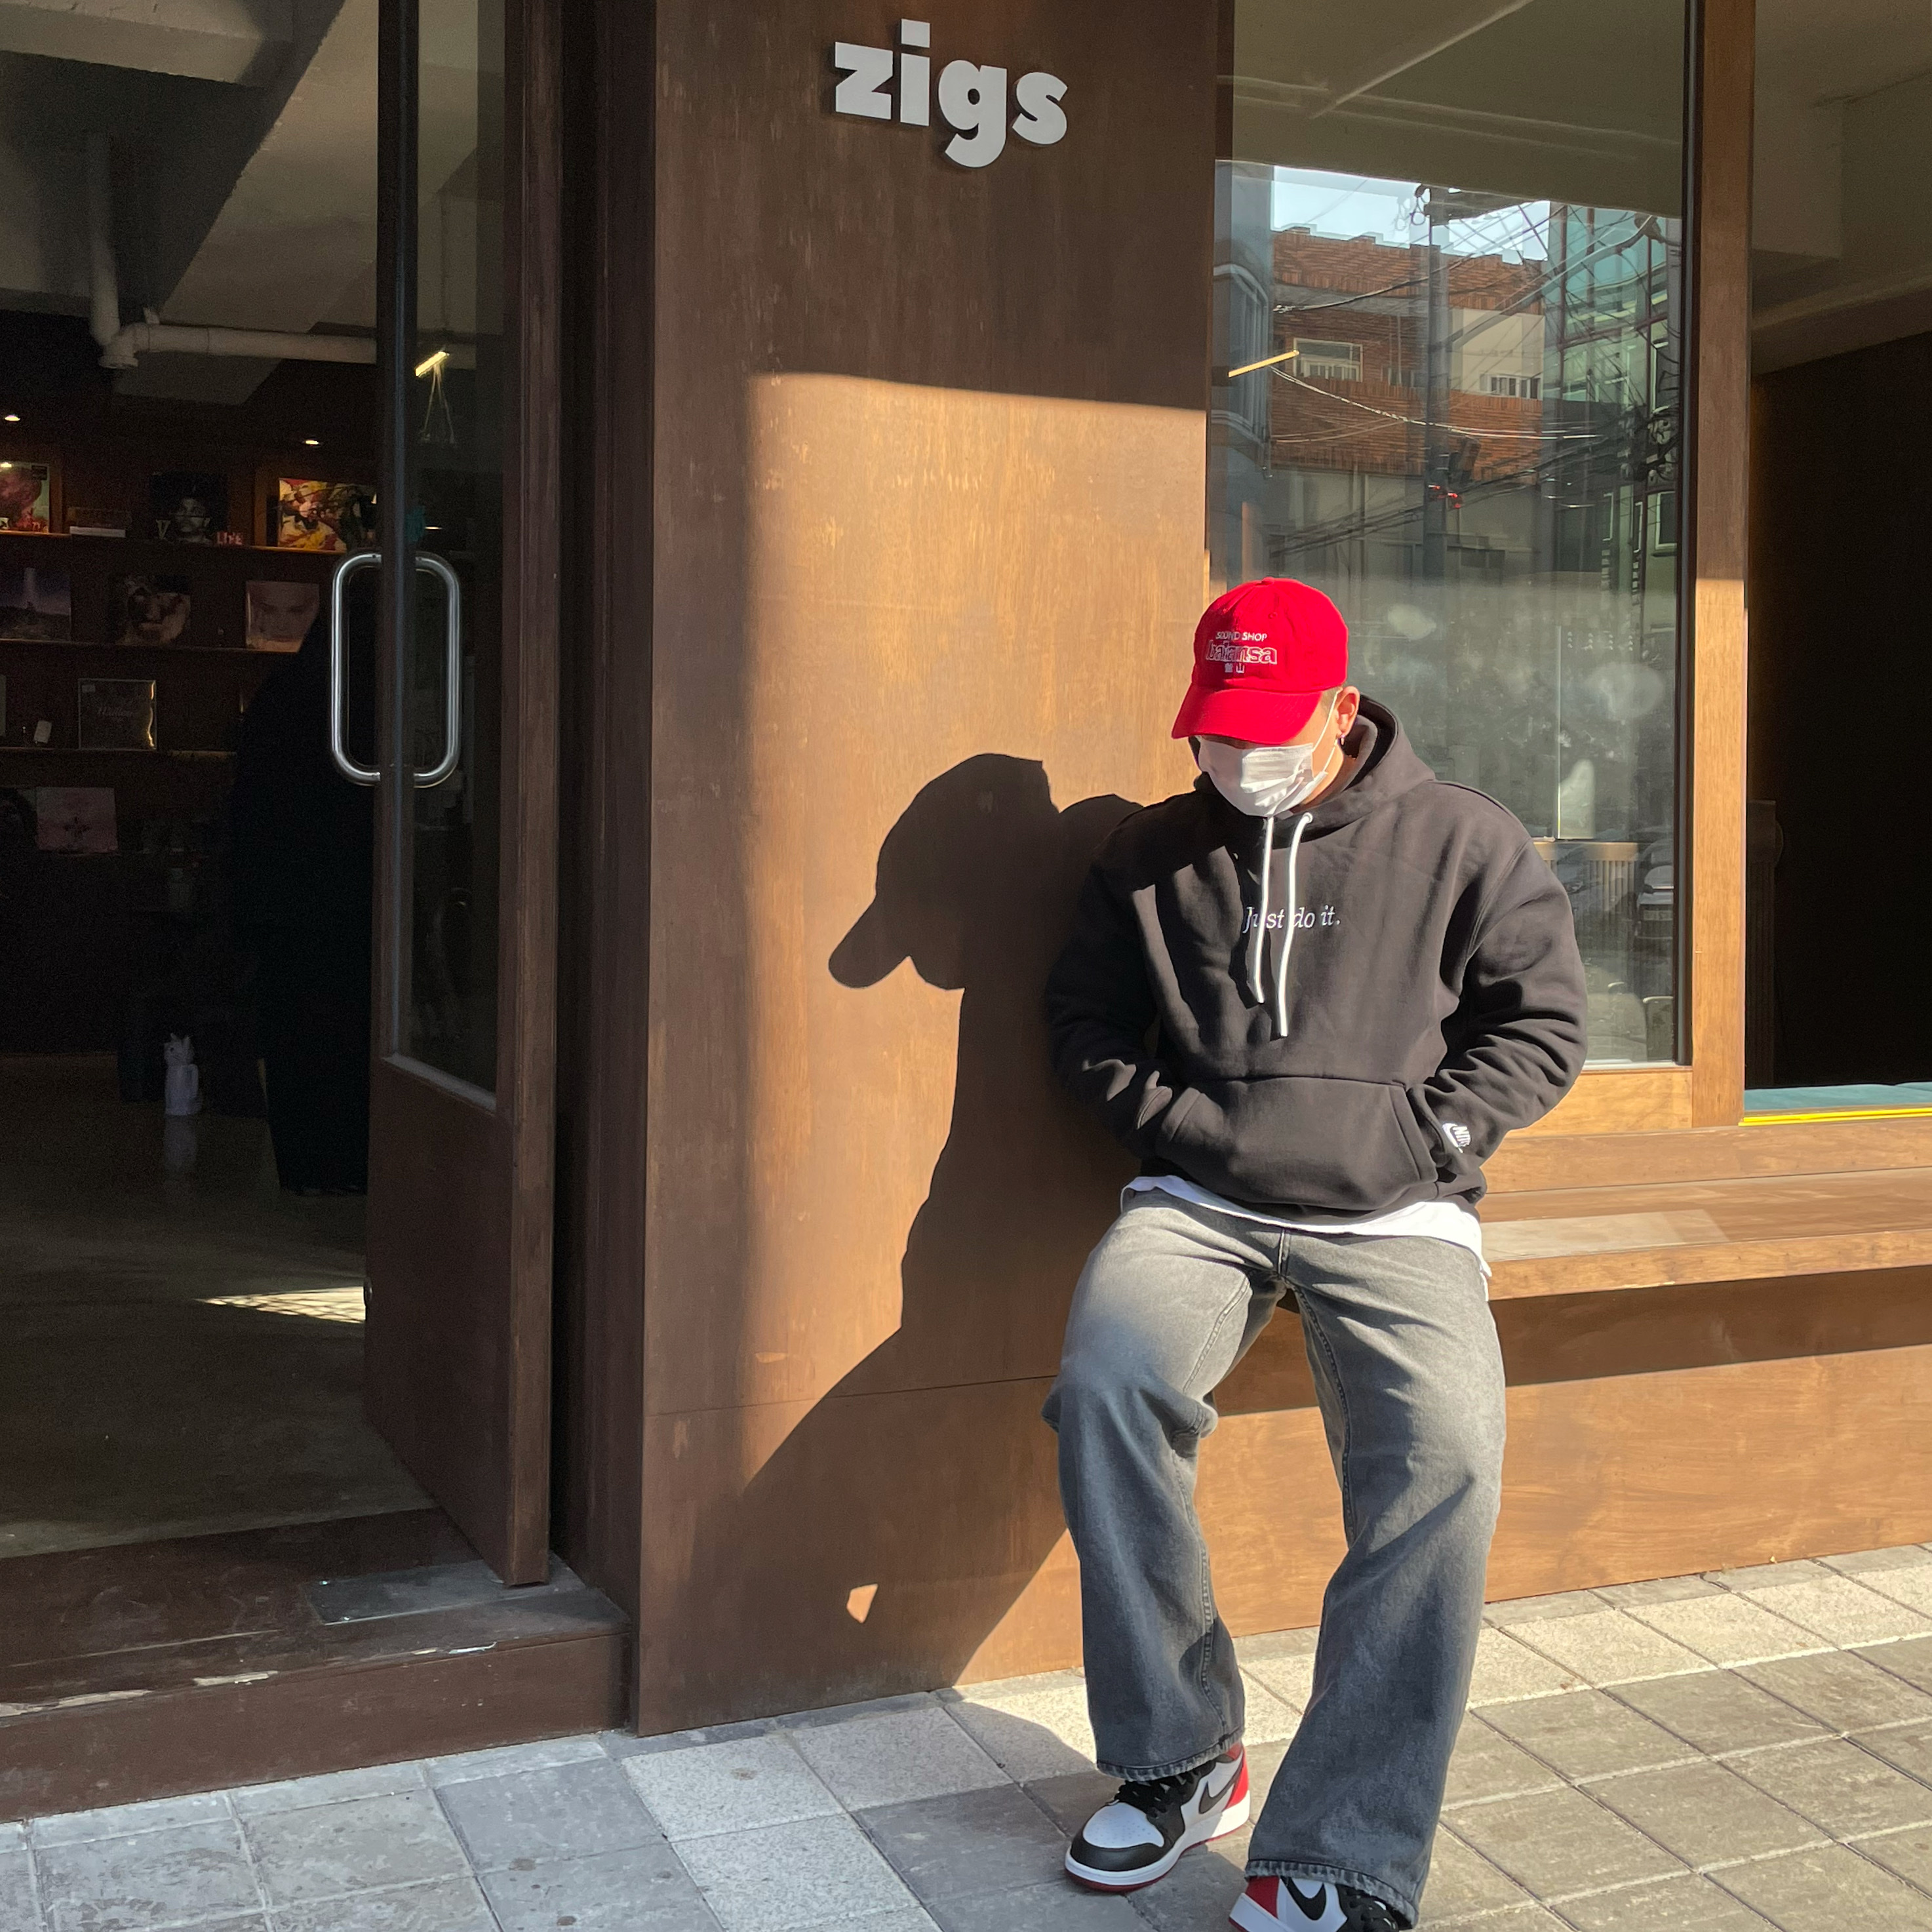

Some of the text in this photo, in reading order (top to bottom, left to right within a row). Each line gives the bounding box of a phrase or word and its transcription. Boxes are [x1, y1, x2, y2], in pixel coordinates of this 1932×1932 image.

[835, 18, 1068, 168] zigs
[1215, 631, 1267, 642] SOUND SHOP
[1292, 907, 1316, 928] do
[1320, 905, 1341, 926] it.
